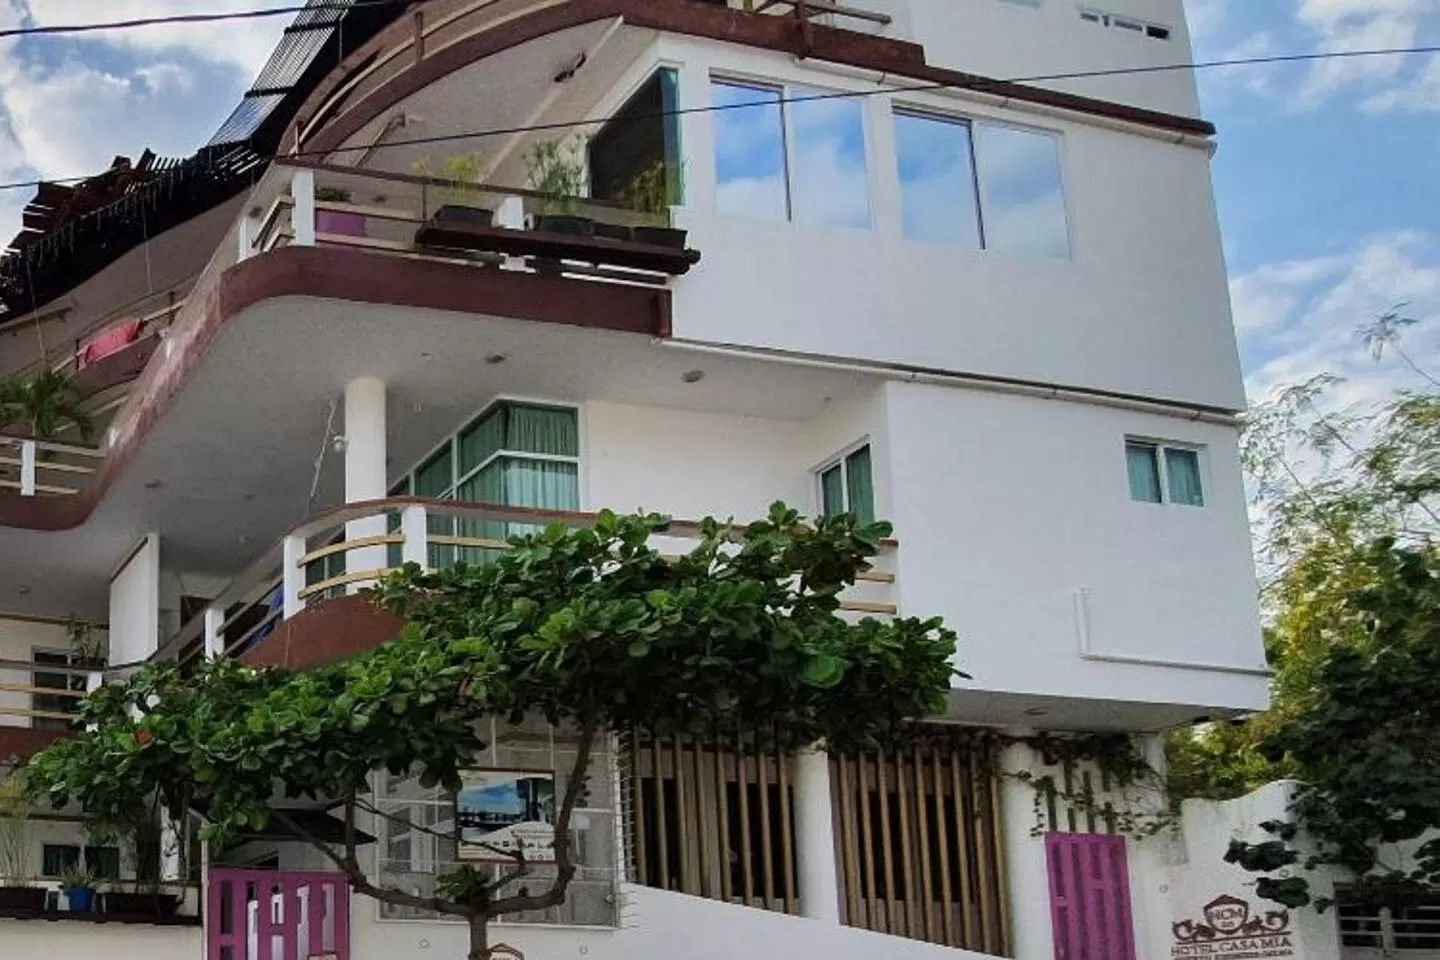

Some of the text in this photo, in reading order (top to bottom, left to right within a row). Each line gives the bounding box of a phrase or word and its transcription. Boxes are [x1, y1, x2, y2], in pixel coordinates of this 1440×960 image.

[1171, 944, 1217, 957] HOTEL
[1220, 940, 1258, 951] CASA
[1259, 937, 1293, 948] MIA
